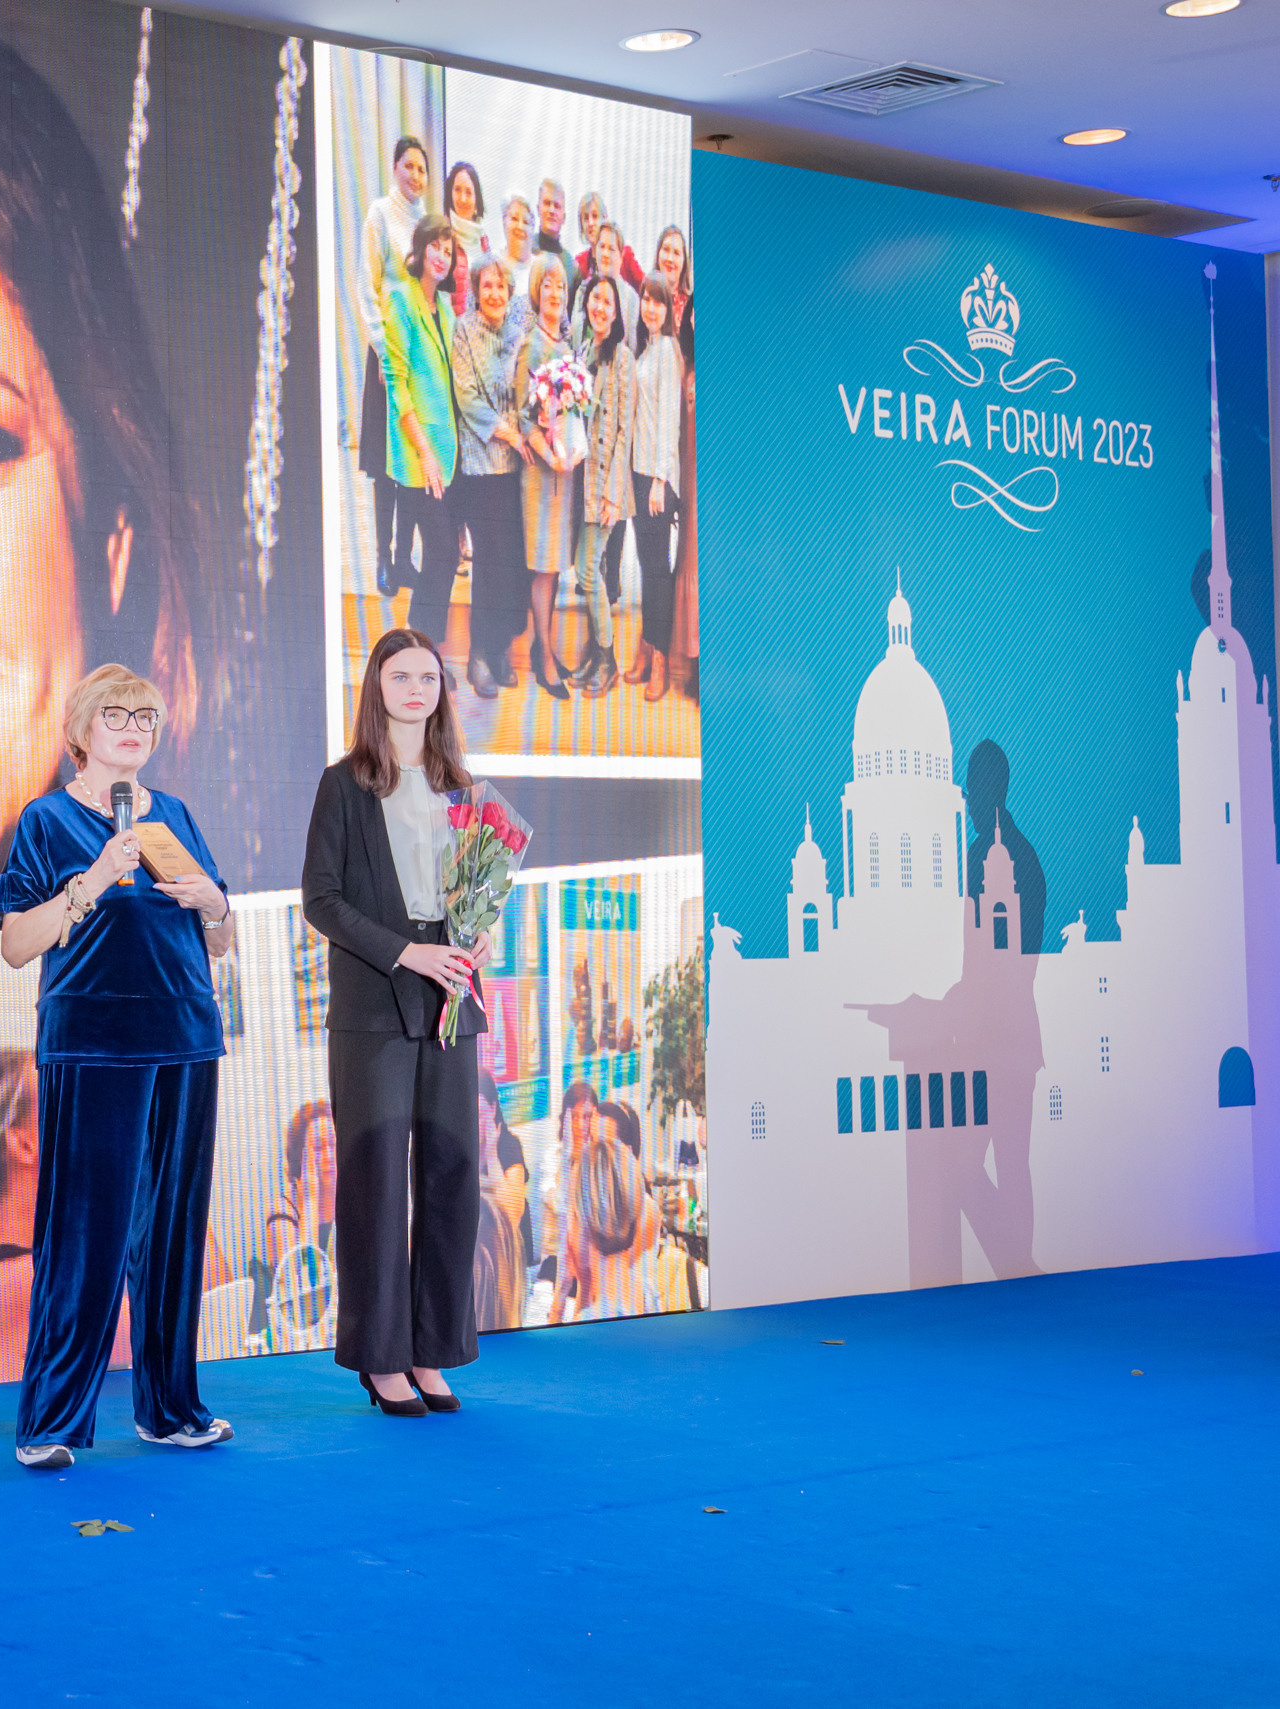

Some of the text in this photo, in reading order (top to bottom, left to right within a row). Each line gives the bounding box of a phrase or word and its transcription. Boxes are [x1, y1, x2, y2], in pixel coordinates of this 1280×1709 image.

[837, 383, 1154, 468] VEIRA FORUM 2023
[584, 899, 622, 920] VEIRA
